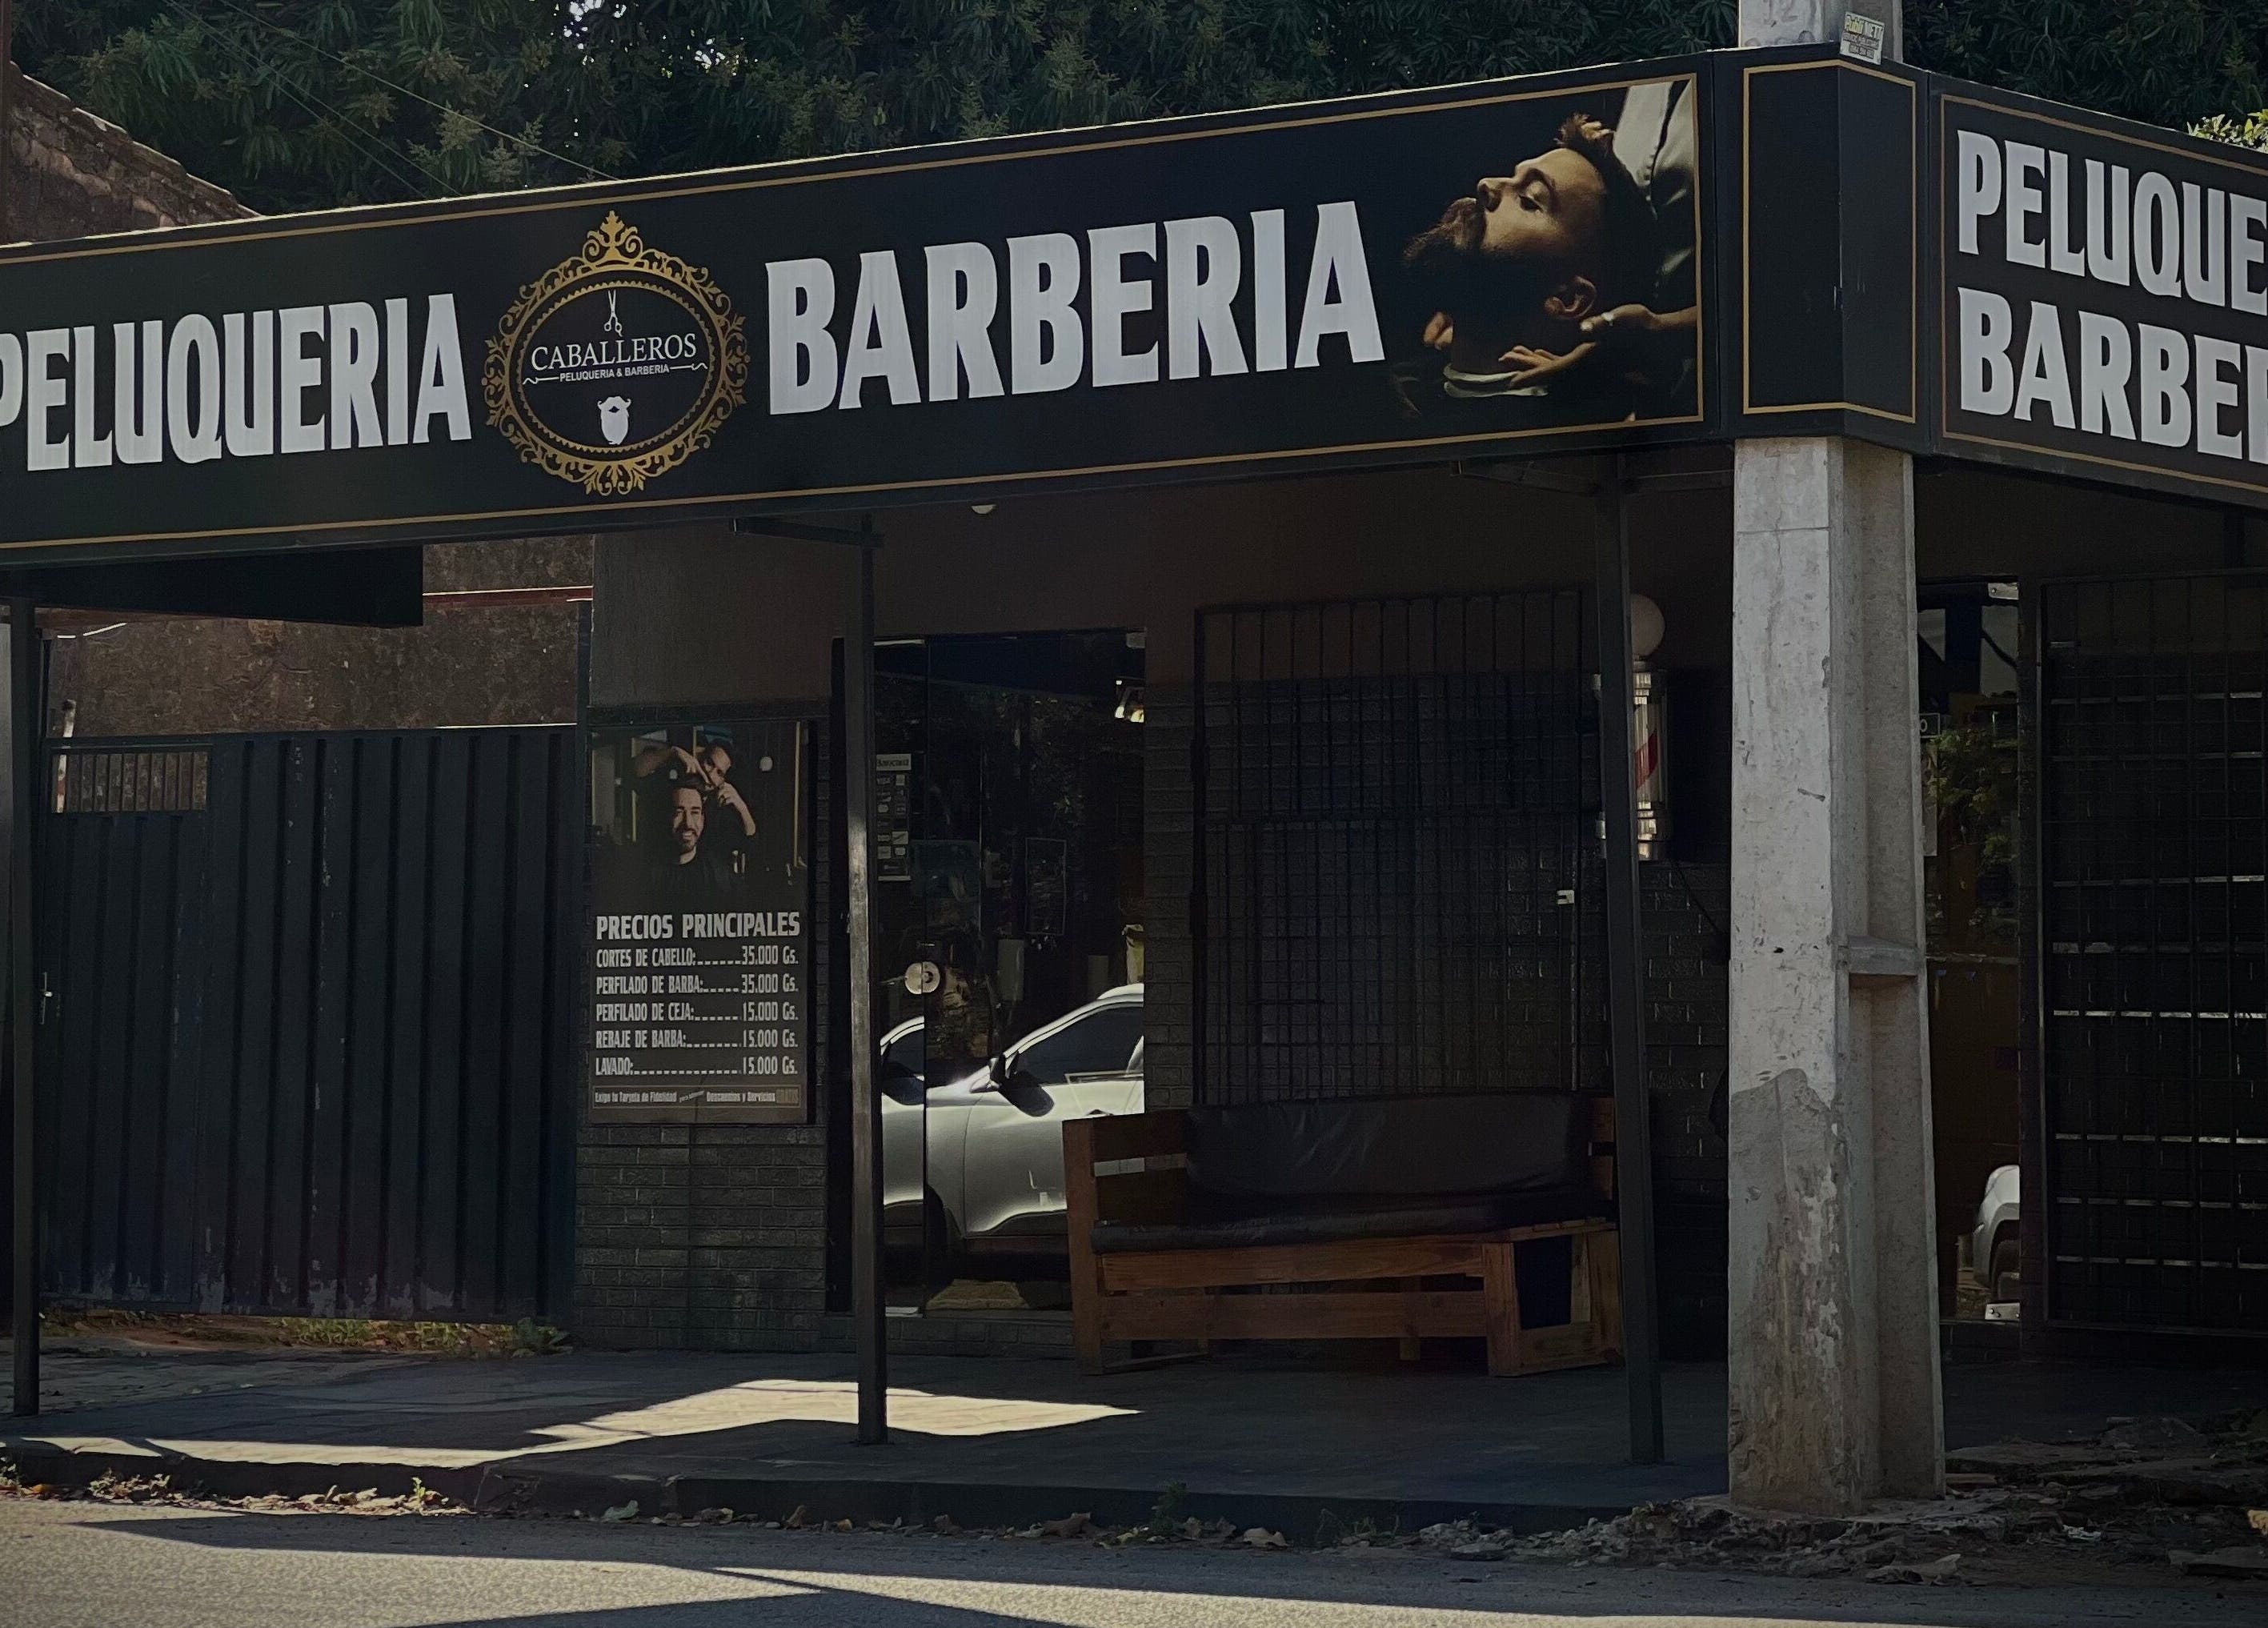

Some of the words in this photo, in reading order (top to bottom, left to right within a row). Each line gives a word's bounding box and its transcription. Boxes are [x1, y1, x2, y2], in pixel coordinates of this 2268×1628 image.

[765, 199, 1385, 415] BARBERIA
[531, 332, 698, 371] CABALLEROS
[559, 369, 615, 383] PELUQUERIA
[616, 367, 623, 377] &
[624, 363, 670, 377] BARBERIA
[596, 914, 673, 940] PRECIOS
[682, 911, 800, 939] PRINCIPALES
[596, 948, 631, 968] CORTES
[635, 948, 648, 967] DE
[741, 945, 779, 965] 35.000
[596, 976, 647, 995] PERFILADO
[651, 975, 664, 994] DE
[741, 973, 779, 993] 35.000
[595, 1003, 647, 1022] PERFILADO
[651, 1003, 664, 1021] DE
[743, 1001, 779, 1021] 15.000
[635, 1029, 647, 1049] DE
[743, 1029, 779, 1049] 15.000
[743, 1056, 779, 1076] 15.000
